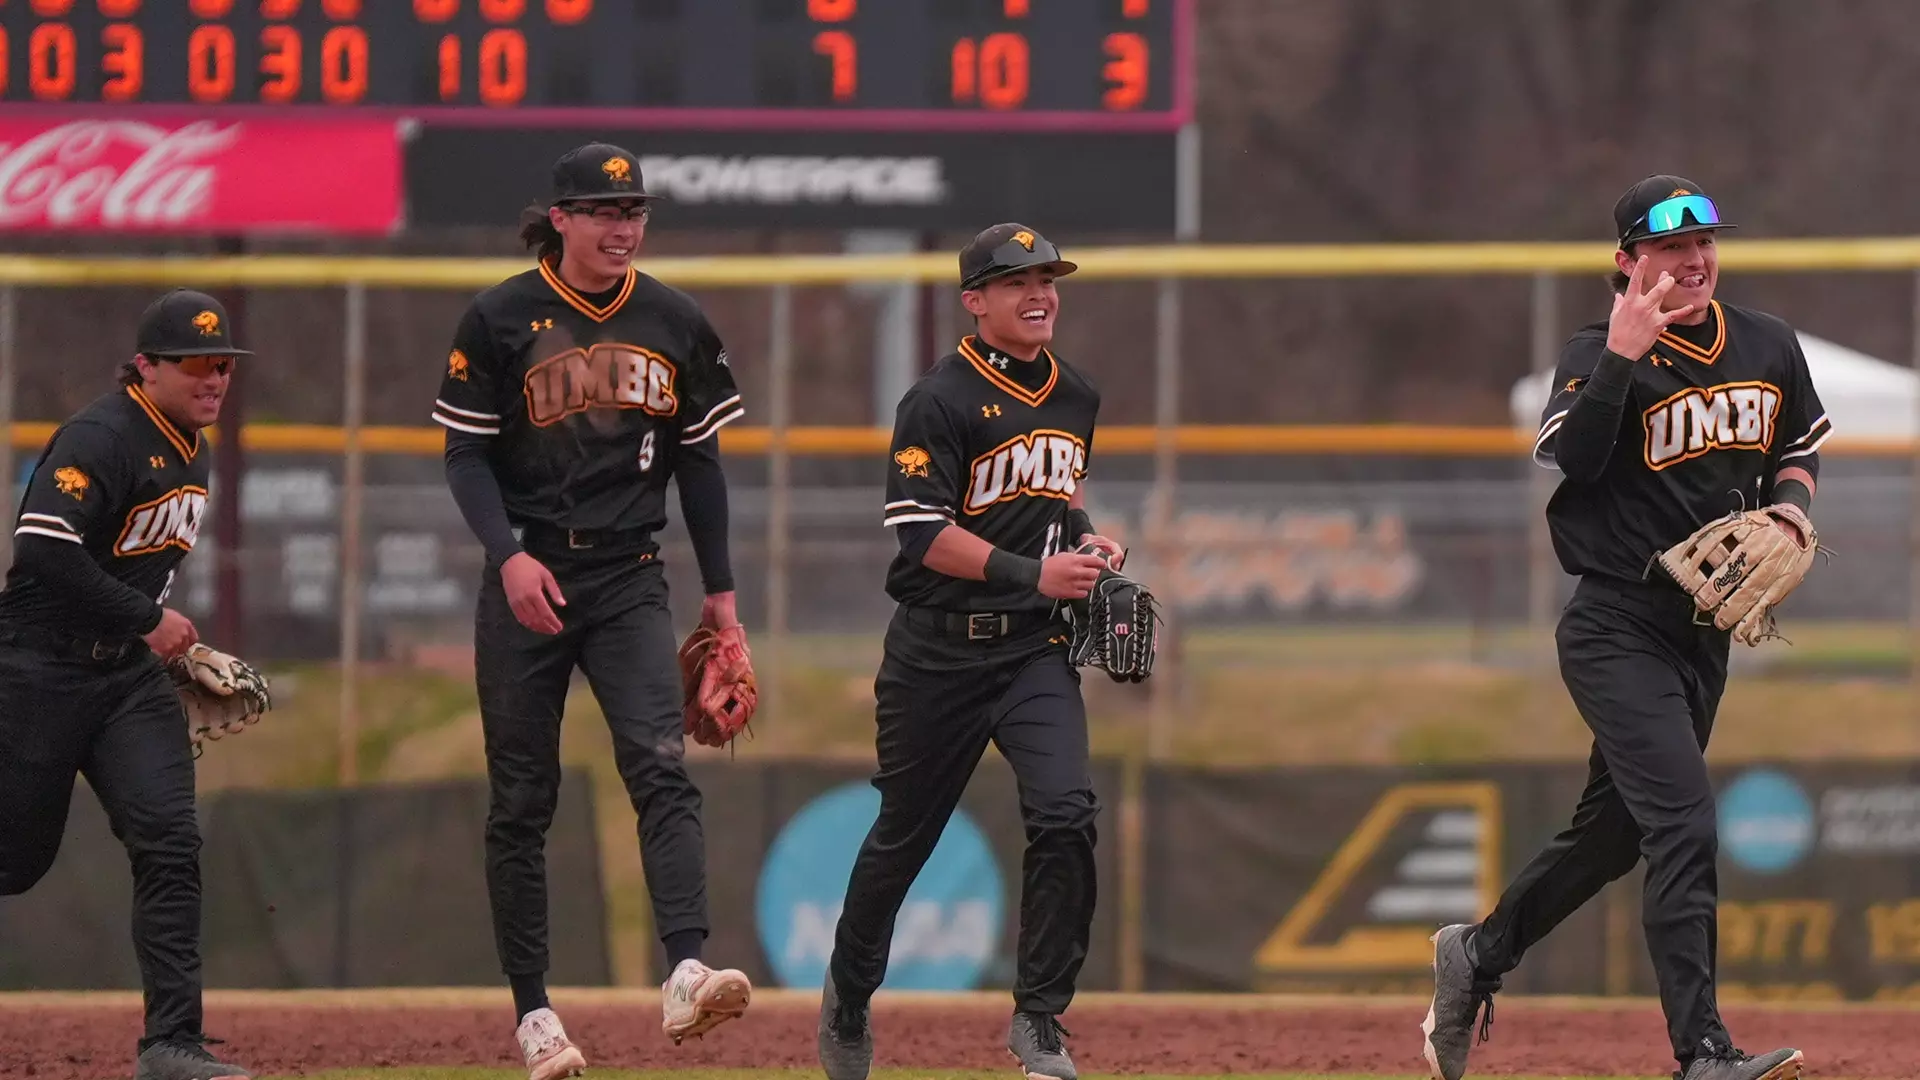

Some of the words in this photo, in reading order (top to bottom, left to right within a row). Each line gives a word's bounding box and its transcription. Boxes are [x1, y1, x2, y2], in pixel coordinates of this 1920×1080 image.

[813, 31, 857, 98] 7
[1103, 33, 1149, 107] 3
[525, 344, 676, 425] UMBC
